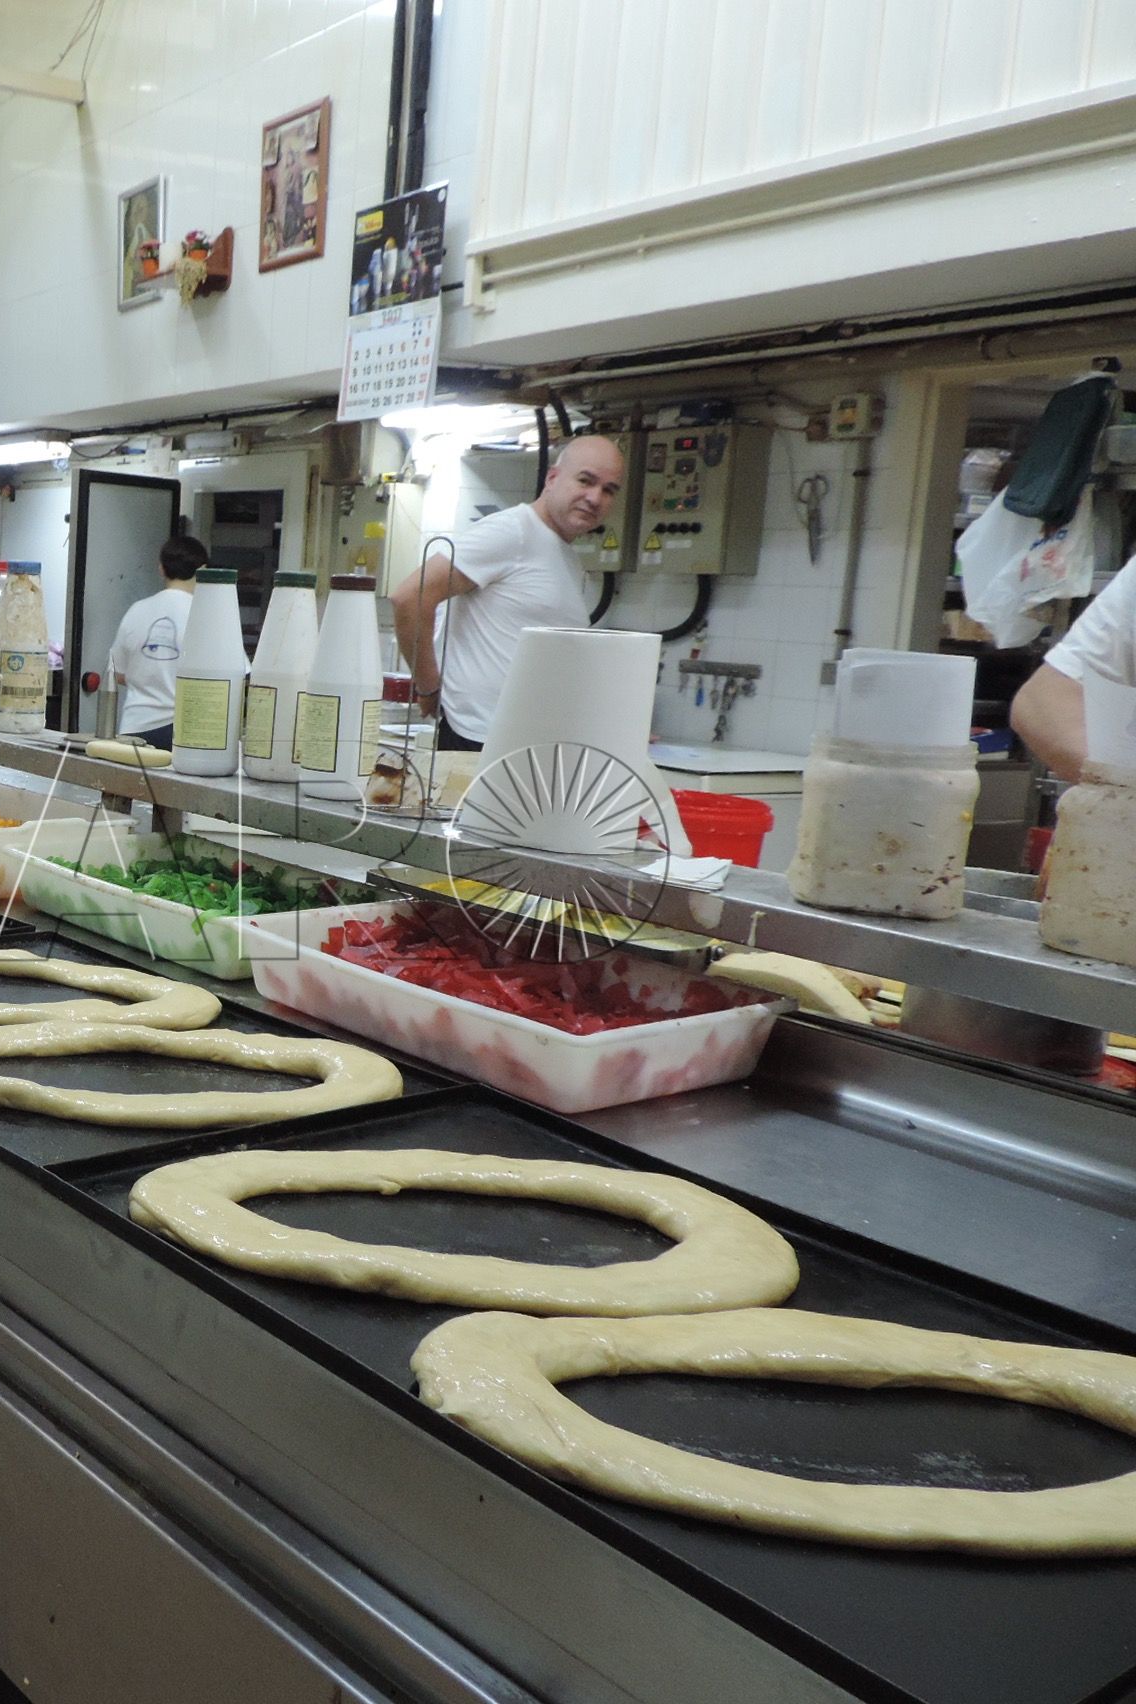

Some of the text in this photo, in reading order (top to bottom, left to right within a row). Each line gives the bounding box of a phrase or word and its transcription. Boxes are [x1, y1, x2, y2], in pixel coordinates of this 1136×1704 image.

[354, 351, 359, 361] 2
[366, 348, 371, 359] 3
[388, 344, 394, 354] 5
[413, 339, 418, 350] 7
[363, 366, 371, 375] 10
[374, 364, 382, 374] 11
[386, 361, 395, 372] 12
[398, 359, 407, 370] 13
[410, 356, 419, 366] 14
[349, 384, 358, 394] 16
[361, 382, 370, 392] 17
